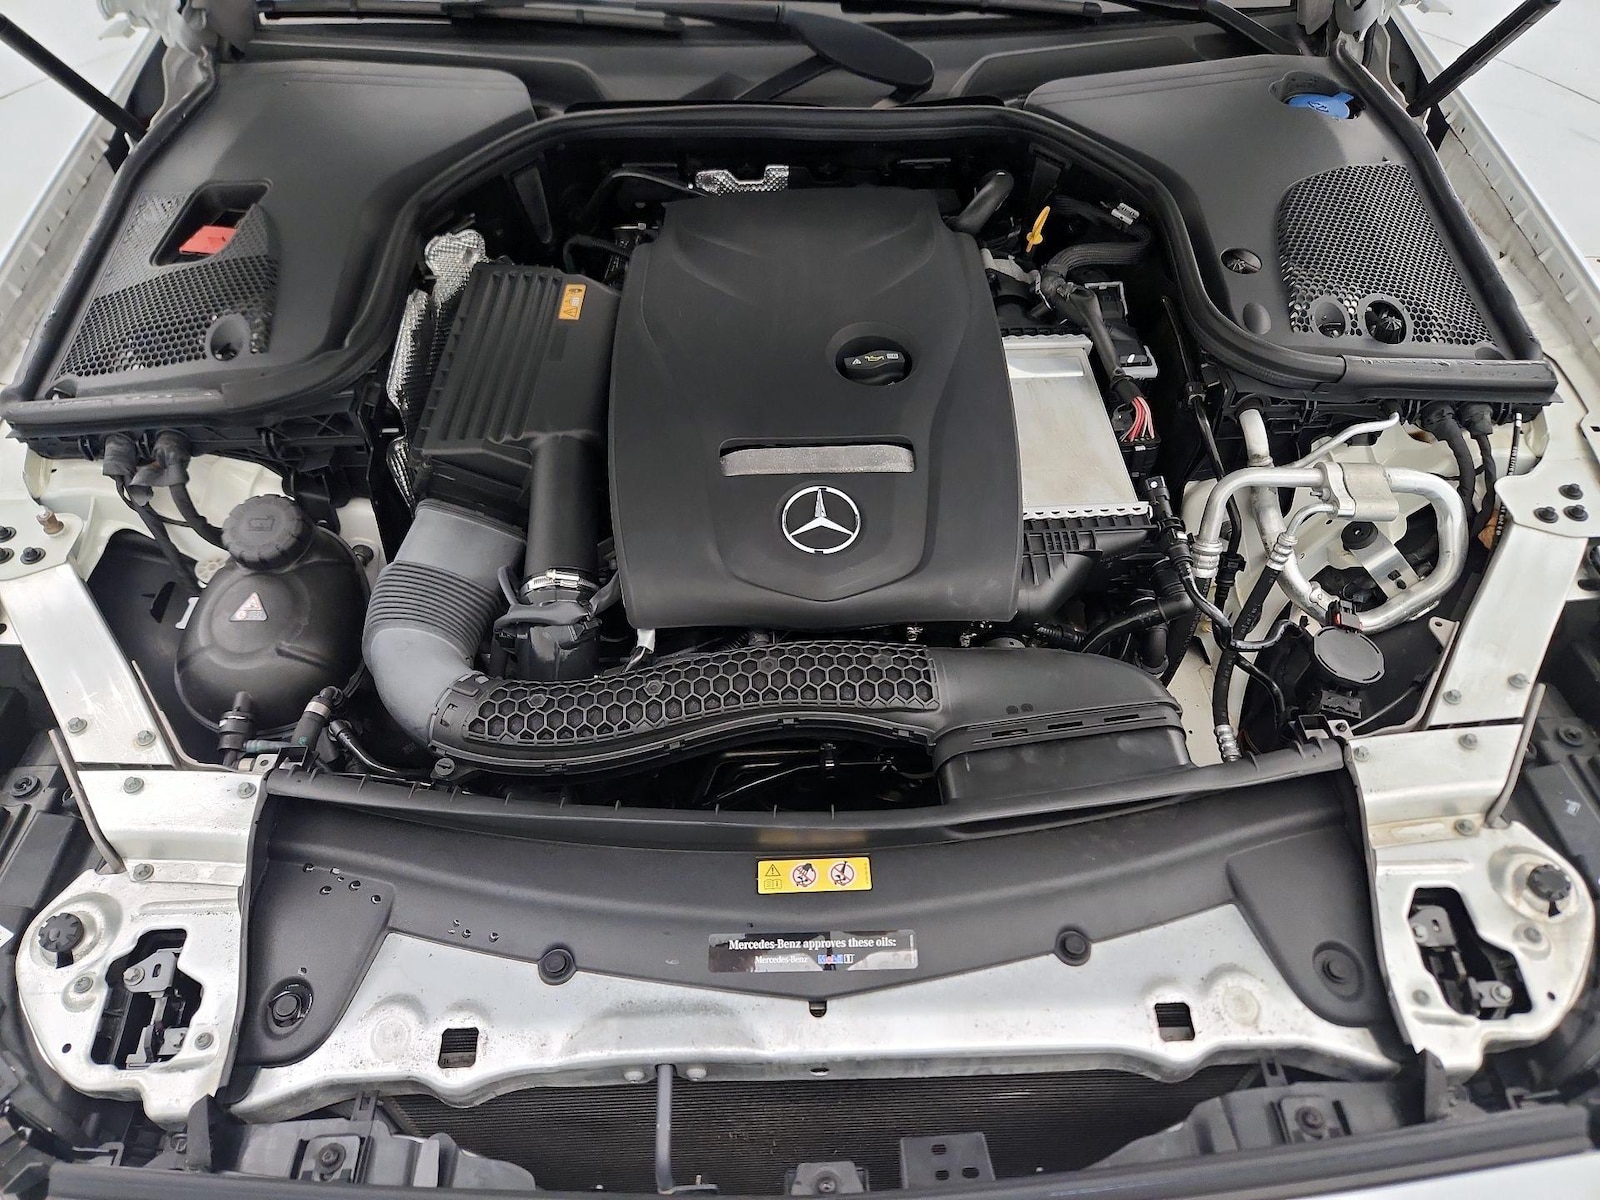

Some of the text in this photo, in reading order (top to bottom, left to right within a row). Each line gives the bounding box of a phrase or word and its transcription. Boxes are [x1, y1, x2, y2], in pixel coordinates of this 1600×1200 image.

[728, 937, 897, 951] Mercedes-Benz approves these oils:
[754, 955, 808, 964] Mercedes-Benz
